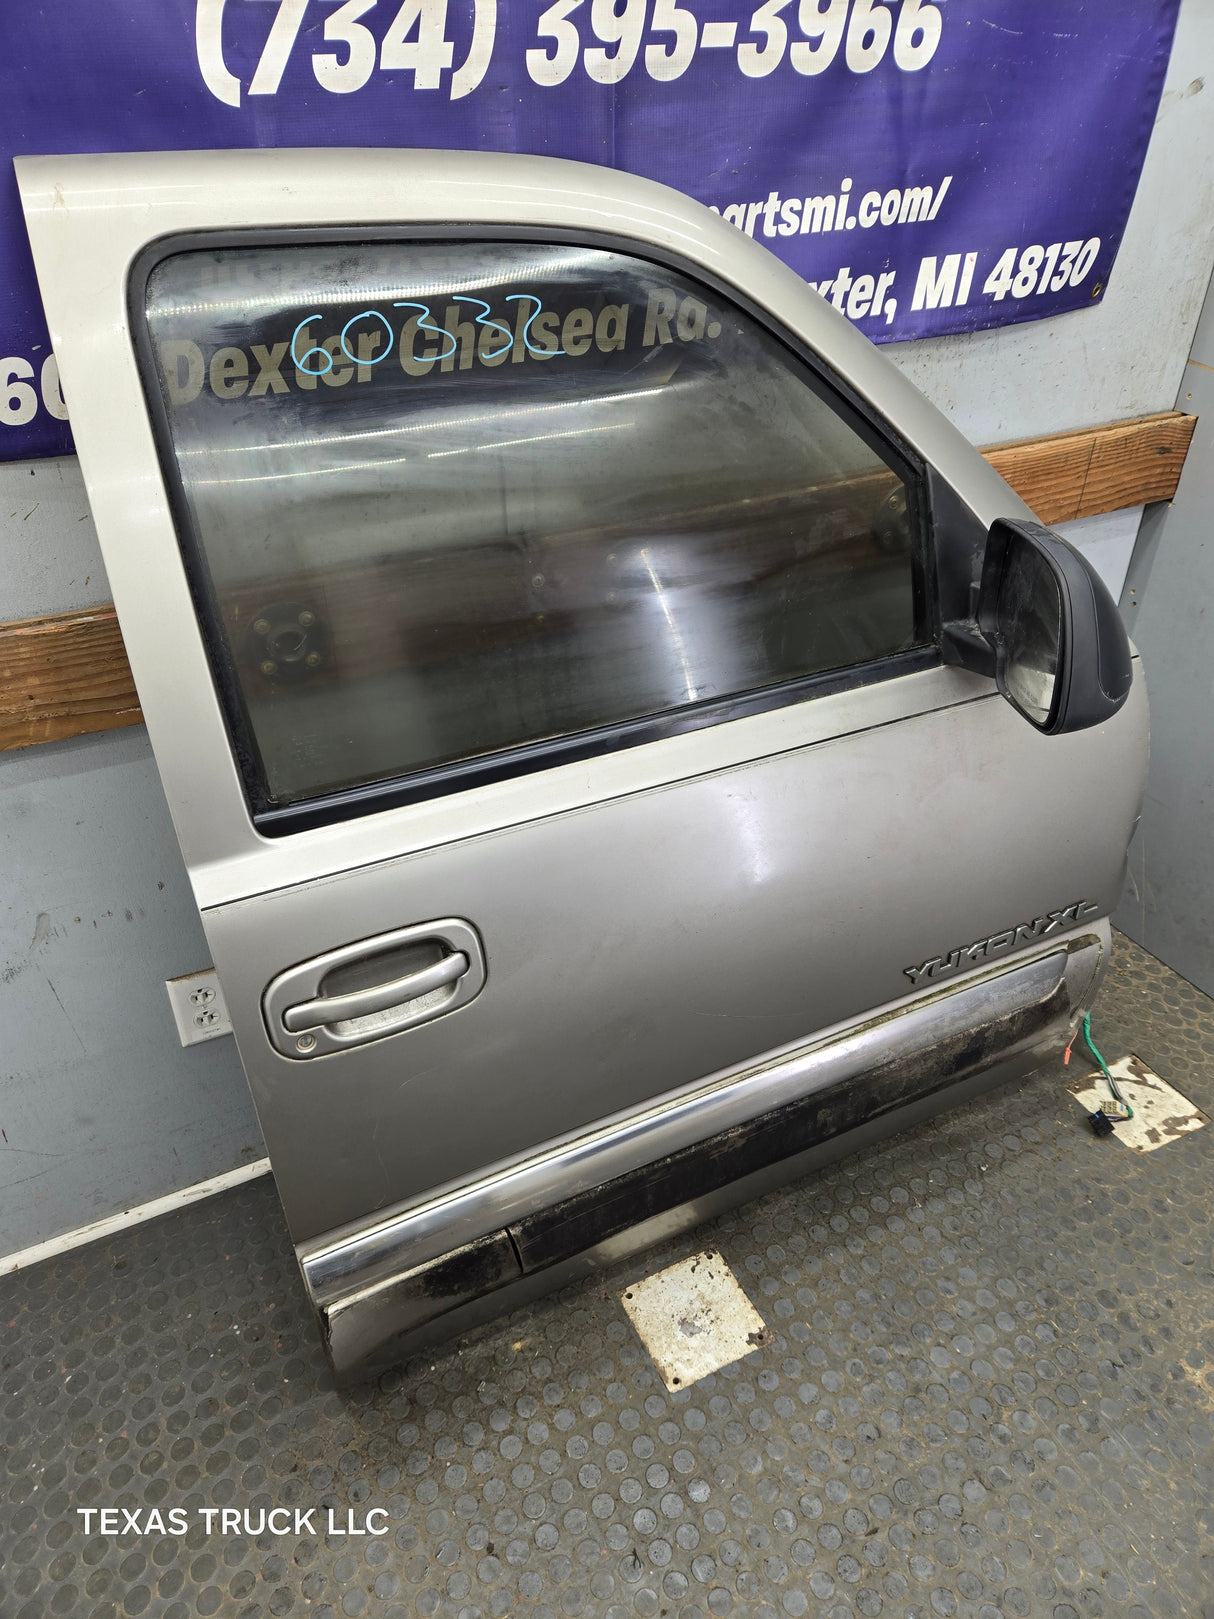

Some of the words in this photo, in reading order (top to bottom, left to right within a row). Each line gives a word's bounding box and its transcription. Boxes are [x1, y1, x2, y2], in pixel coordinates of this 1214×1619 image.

[708, 176, 953, 238] artsmi.com/
[161, 324, 382, 406] Dexter
[399, 299, 629, 376] Chelsea
[910, 252, 976, 312] MI
[982, 237, 1101, 303] 48130
[291, 294, 566, 376] 60332
[1044, 900, 1099, 934] XL
